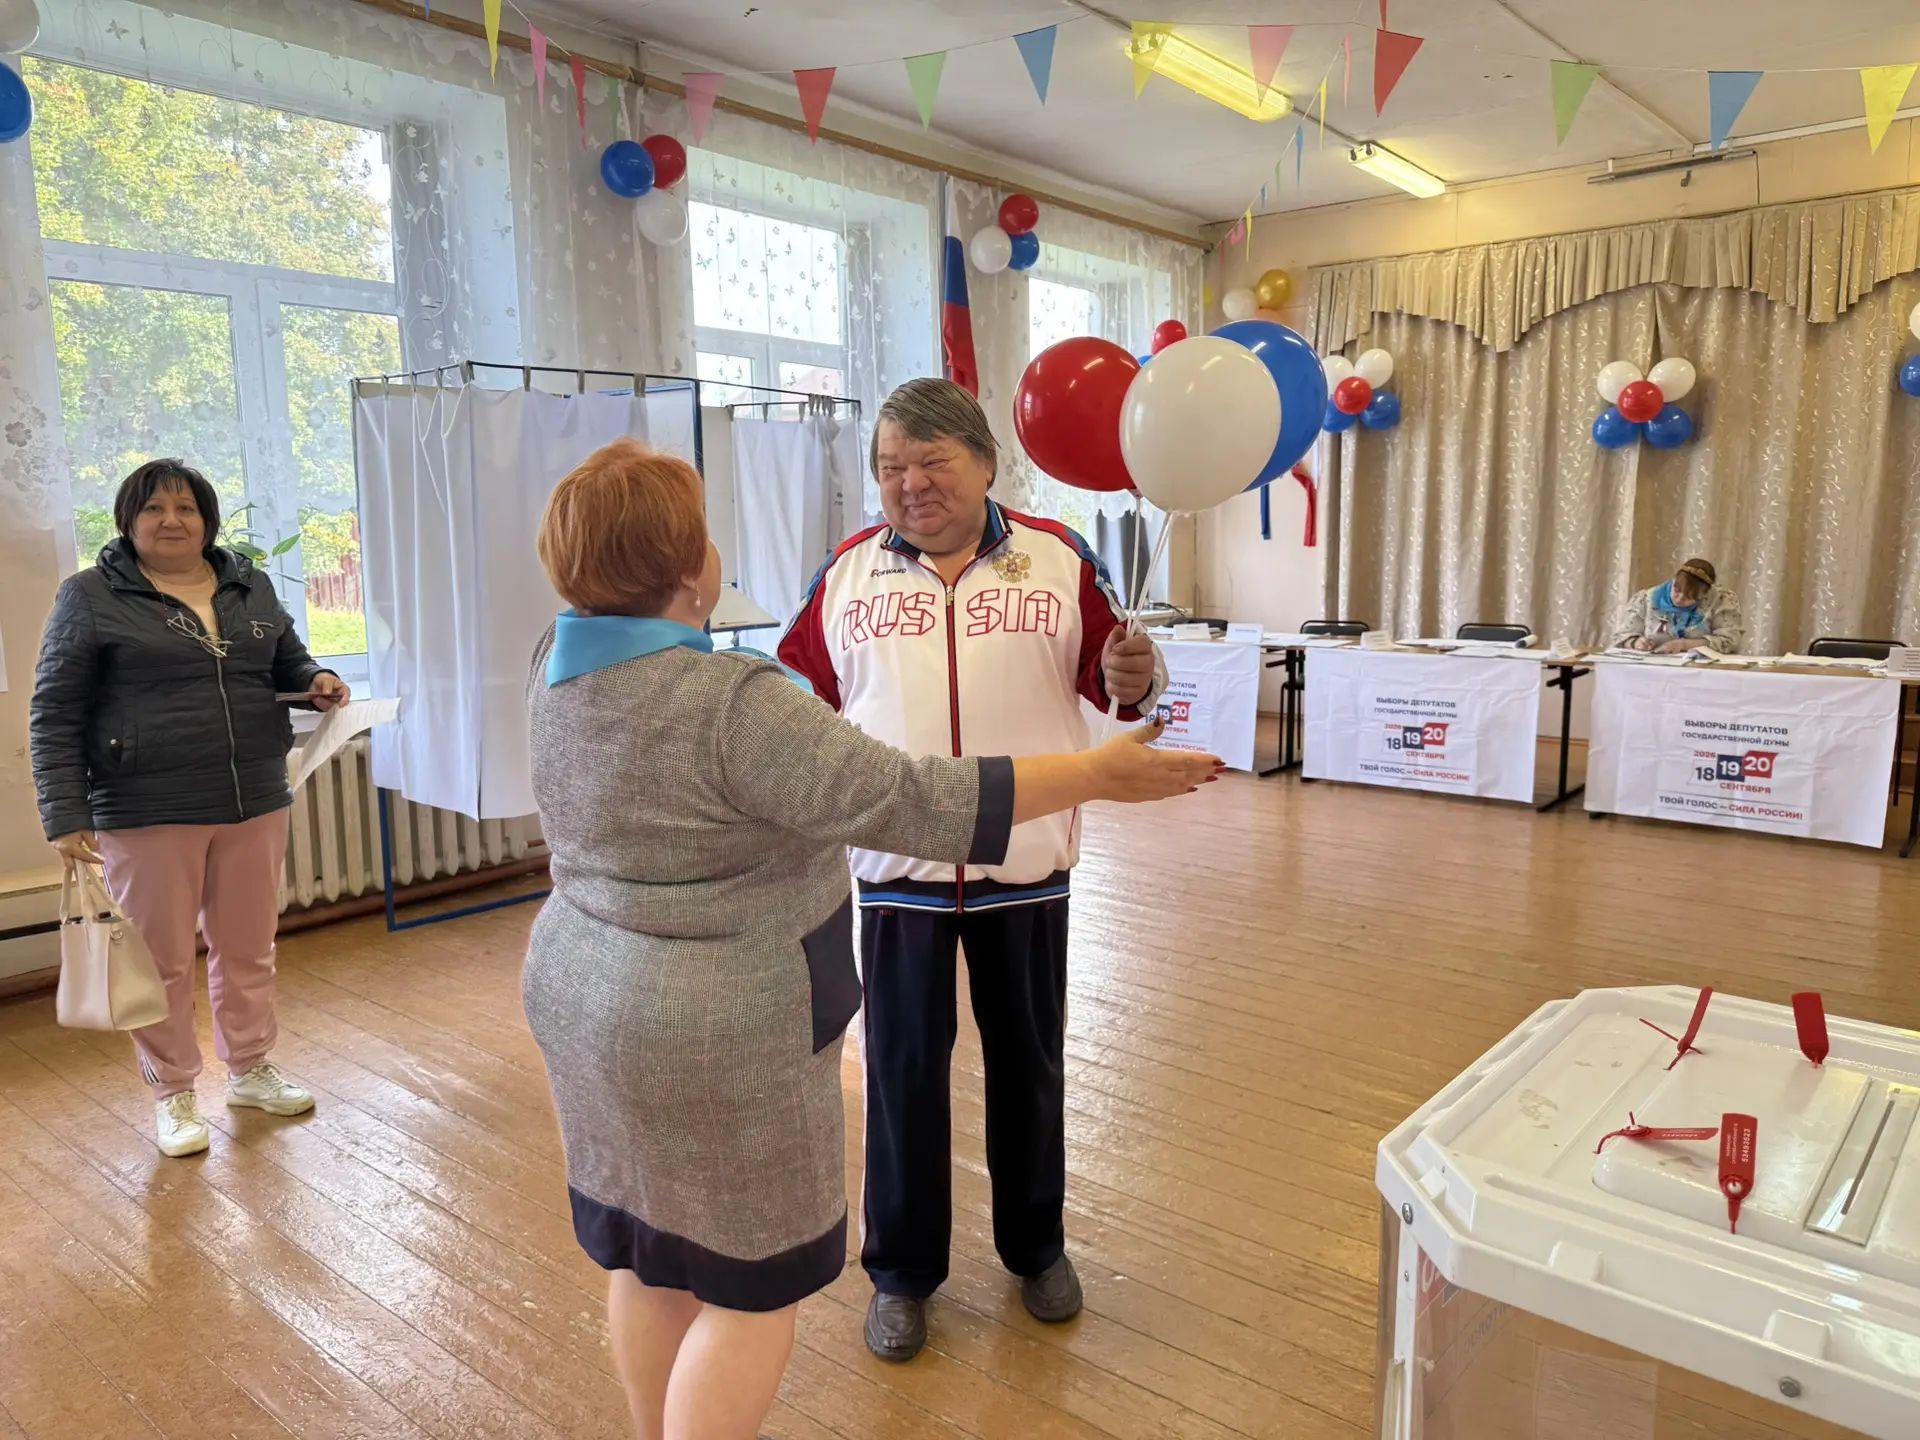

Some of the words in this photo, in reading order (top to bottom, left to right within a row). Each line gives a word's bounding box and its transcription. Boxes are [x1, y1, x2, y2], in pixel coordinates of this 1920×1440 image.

[870, 568, 907, 578] FORWARD
[1376, 697, 1409, 705] ВЫБОРЫ
[1411, 699, 1456, 708] ДЕПУТАТОВ
[1172, 704, 1187, 717] 20
[1684, 720, 1727, 730] ВЫБОРЫ
[1728, 723, 1788, 735] ДЕПУТАТОВ
[1386, 737, 1401, 750] 18
[1404, 732, 1421, 745] 19
[1423, 727, 1444, 741] 20
[1681, 731, 1762, 745] ГОСУДАРСТВЕННОЙ
[1763, 738, 1790, 747] ДУМЫ
[1406, 750, 1445, 760] СЕНТЯБРЯ
[1694, 750, 1716, 759] 2026
[1360, 763, 1379, 771] ТВОЙ
[1380, 766, 1406, 775] ГОЛОС
[1413, 769, 1434, 777] СИЛА
[1695, 767, 1715, 781] 18
[1719, 761, 1740, 776] 19
[1744, 756, 1770, 772] 20
[1720, 782, 1771, 794] СЕНТЯБРЯ
[1659, 795, 1684, 805] ТВОЙ
[1686, 798, 1718, 809] ГОЛОС
[1728, 804, 1755, 814] СИЛА
[1758, 808, 1803, 820] РОССИИ!
